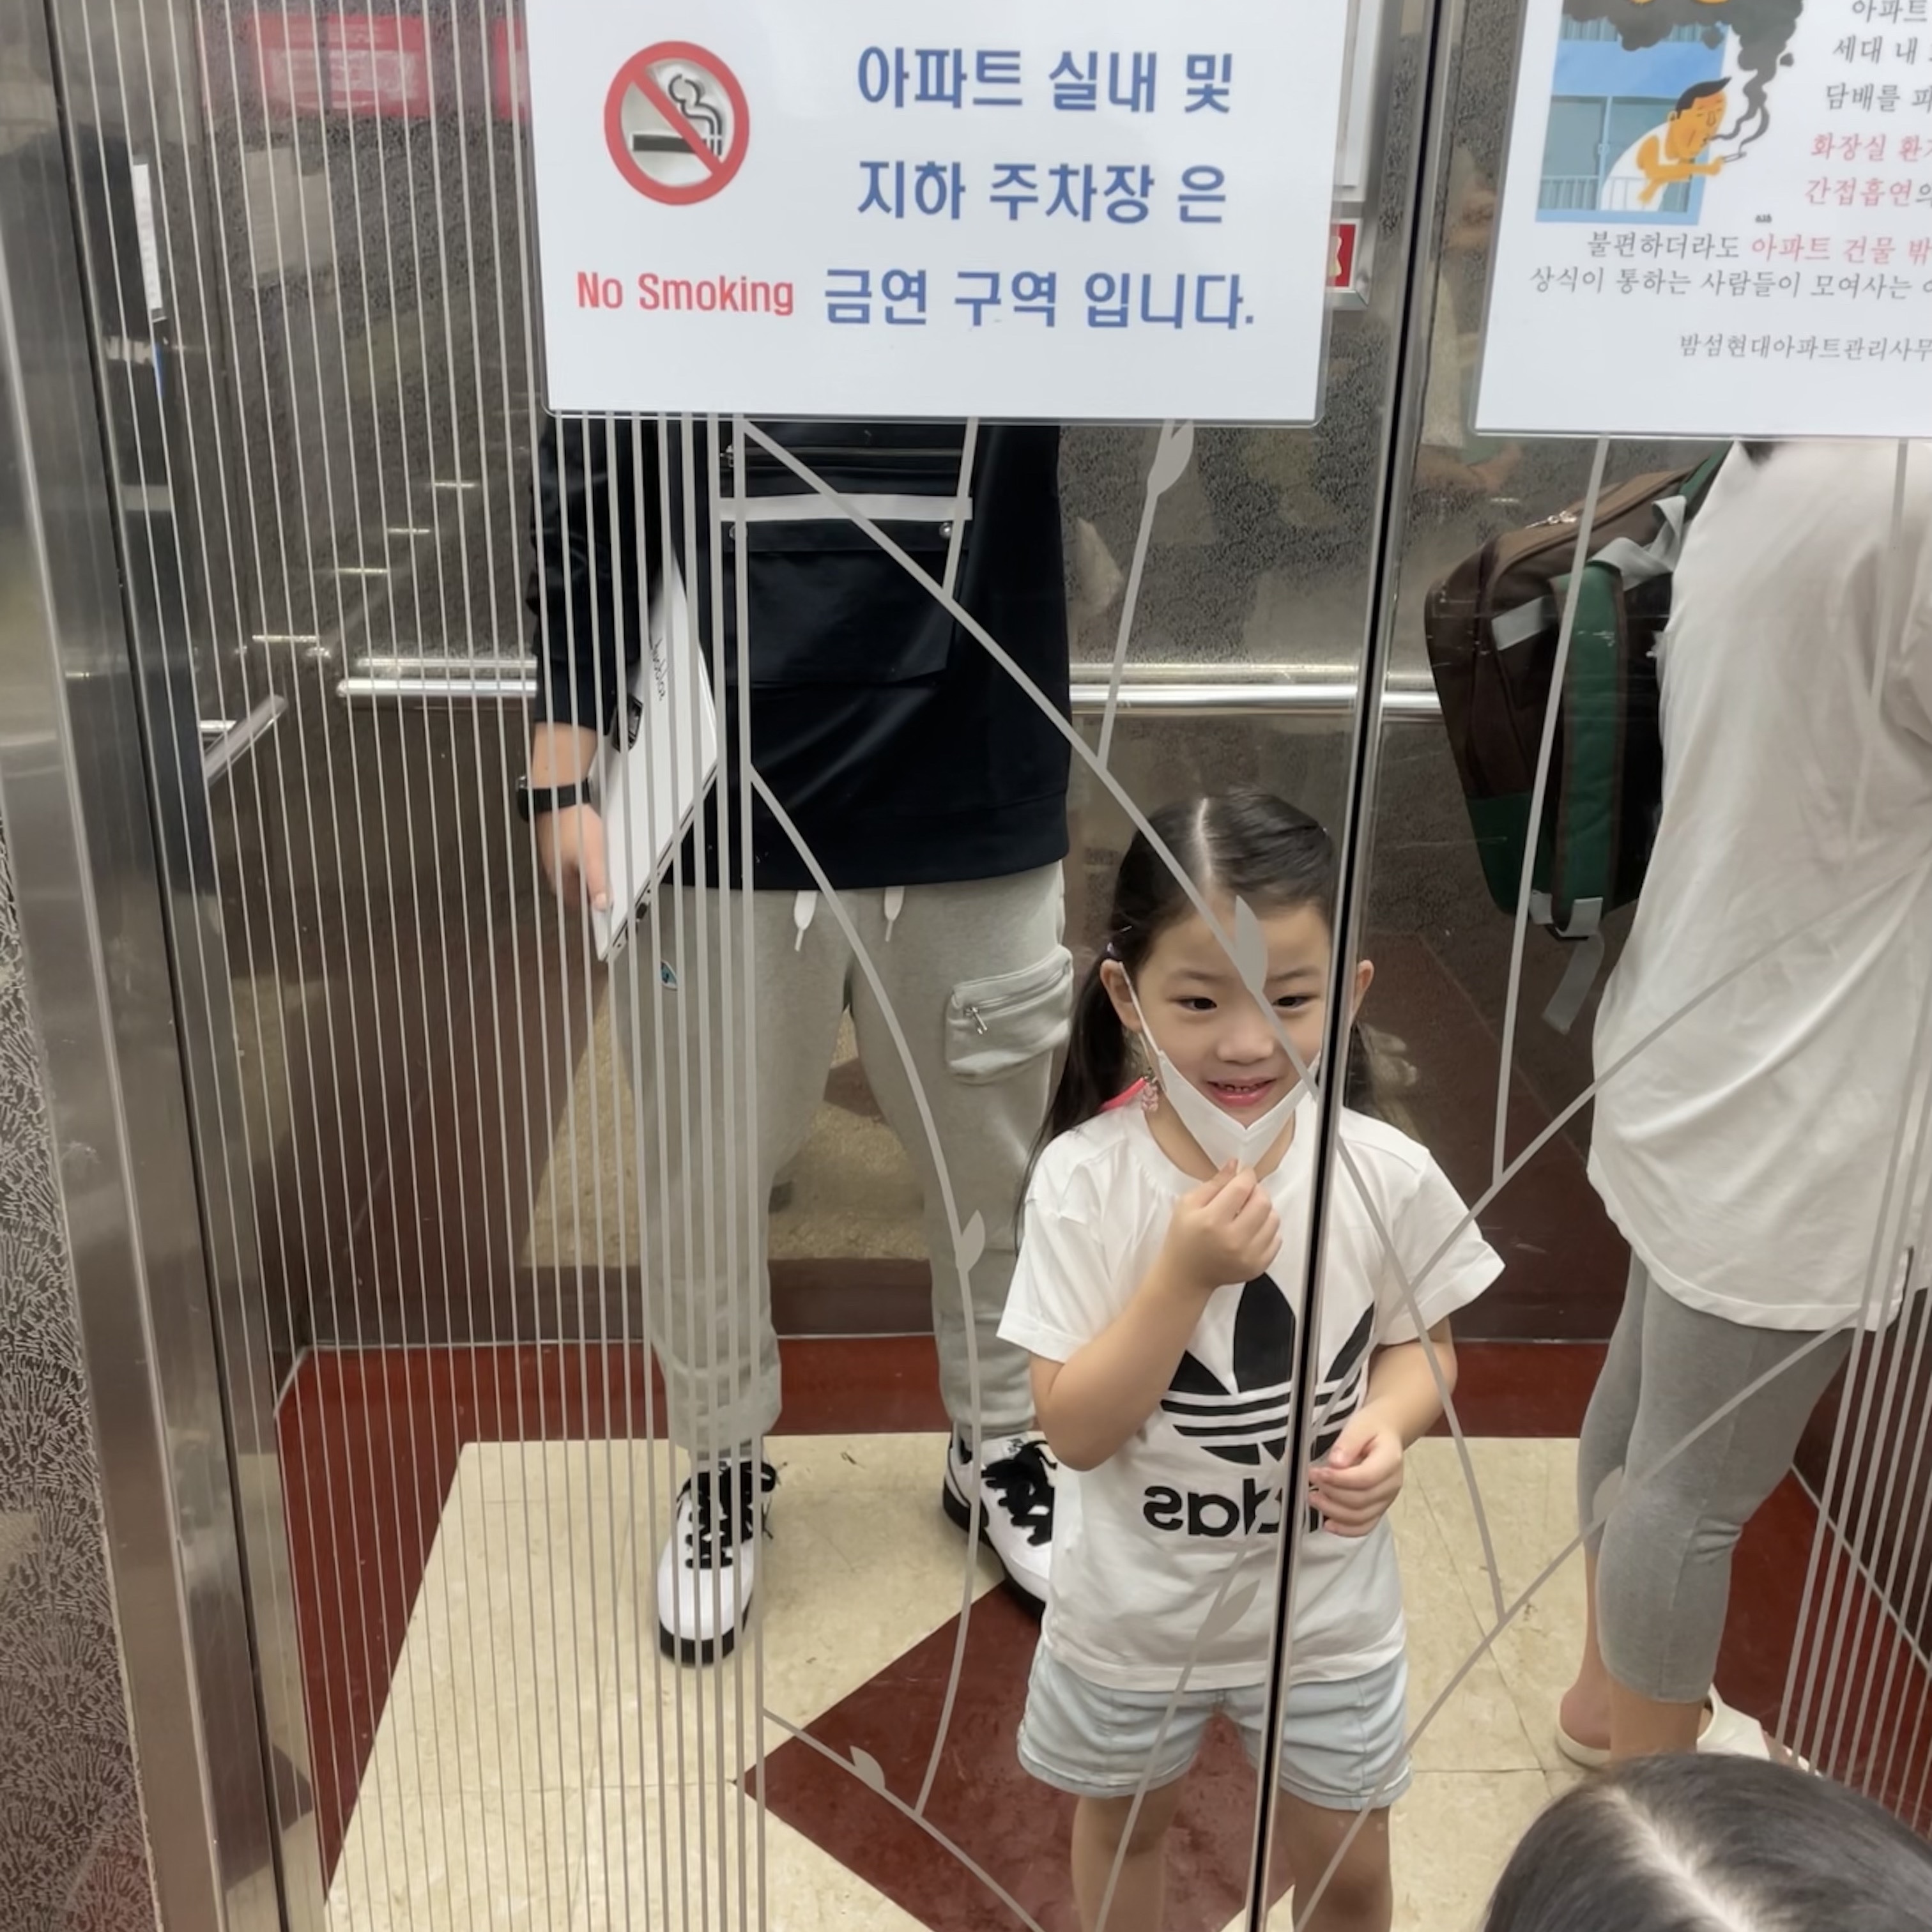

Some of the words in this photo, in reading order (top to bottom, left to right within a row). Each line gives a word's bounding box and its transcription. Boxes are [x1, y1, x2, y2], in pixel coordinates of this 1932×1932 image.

[1852, 0, 1927, 24] 아파트
[1833, 34, 1883, 64] 세대
[1896, 37, 1918, 65] 내
[858, 46, 1023, 109] 아파트
[1048, 50, 1156, 112] 실내
[1184, 53, 1232, 114] 및
[1827, 82, 1901, 112] 담배를
[1811, 133, 1886, 161] 화장실
[858, 160, 966, 220] 지하
[990, 163, 1154, 224] 주차장
[1177, 165, 1226, 224] 은
[1588, 231, 1738, 259] 불편하더라도
[1752, 234, 1830, 261] 아파트
[1845, 236, 1895, 264] 건물
[578, 272, 623, 309] No
[638, 273, 793, 316] Smoking
[1531, 266, 1604, 293] 상식이
[1616, 268, 1691, 295] 통하는
[1702, 270, 1800, 298] 사람들이
[1811, 273, 1912, 299] 모여사는
[825, 269, 926, 325] 금연
[954, 271, 1056, 328] 구역
[1085, 272, 1254, 330] 입니다.
